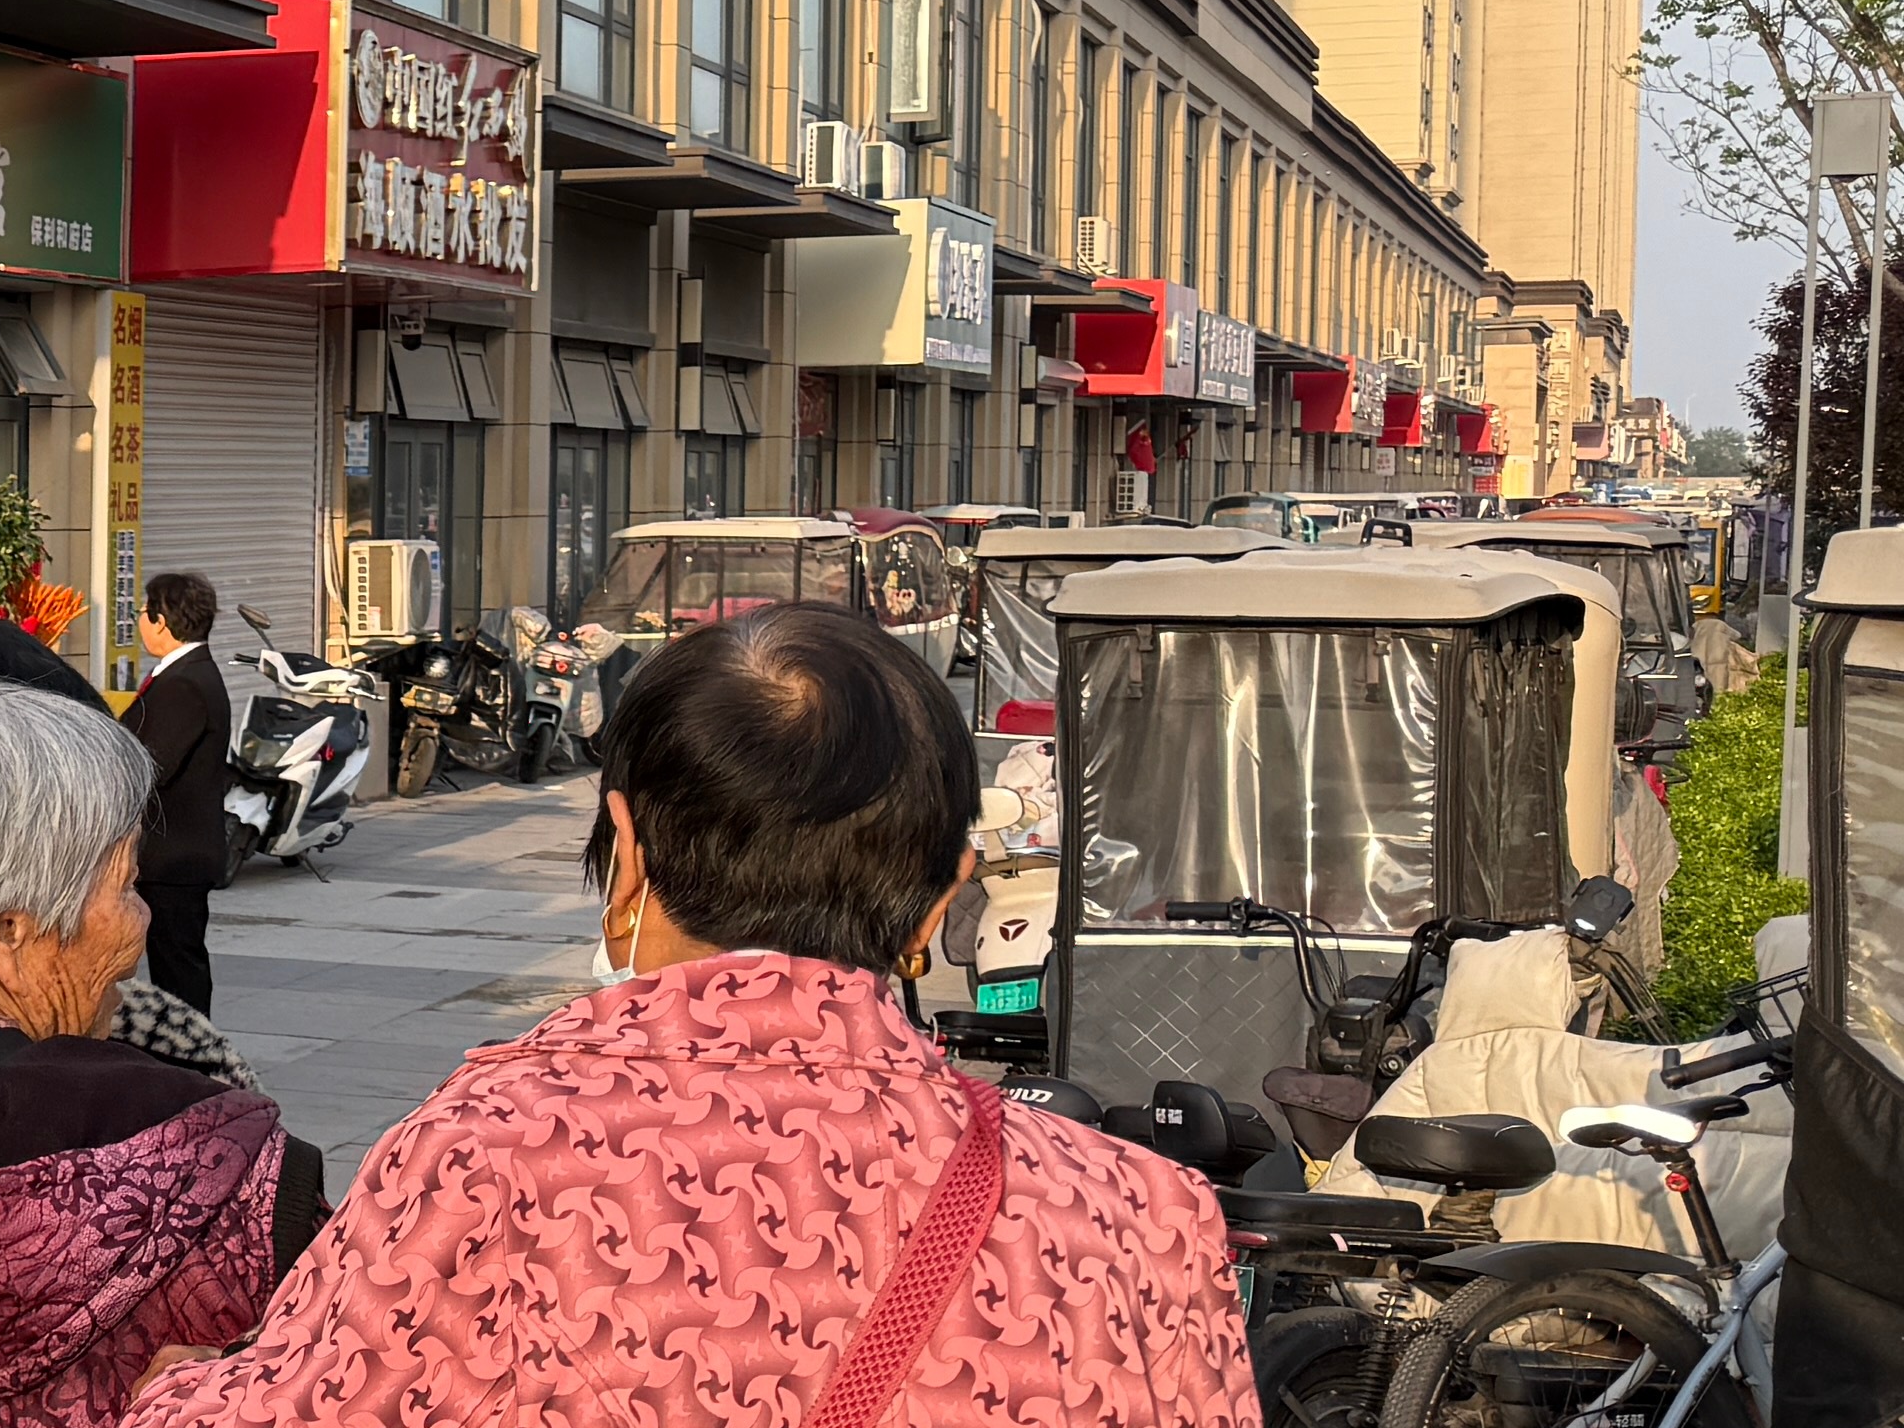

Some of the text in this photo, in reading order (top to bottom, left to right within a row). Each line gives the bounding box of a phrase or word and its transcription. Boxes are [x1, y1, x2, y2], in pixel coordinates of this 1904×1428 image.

[113, 303, 142, 348] 名烟
[112, 363, 141, 406] 名酒
[111, 422, 140, 464] 名茶
[110, 482, 139, 523] 礼品
